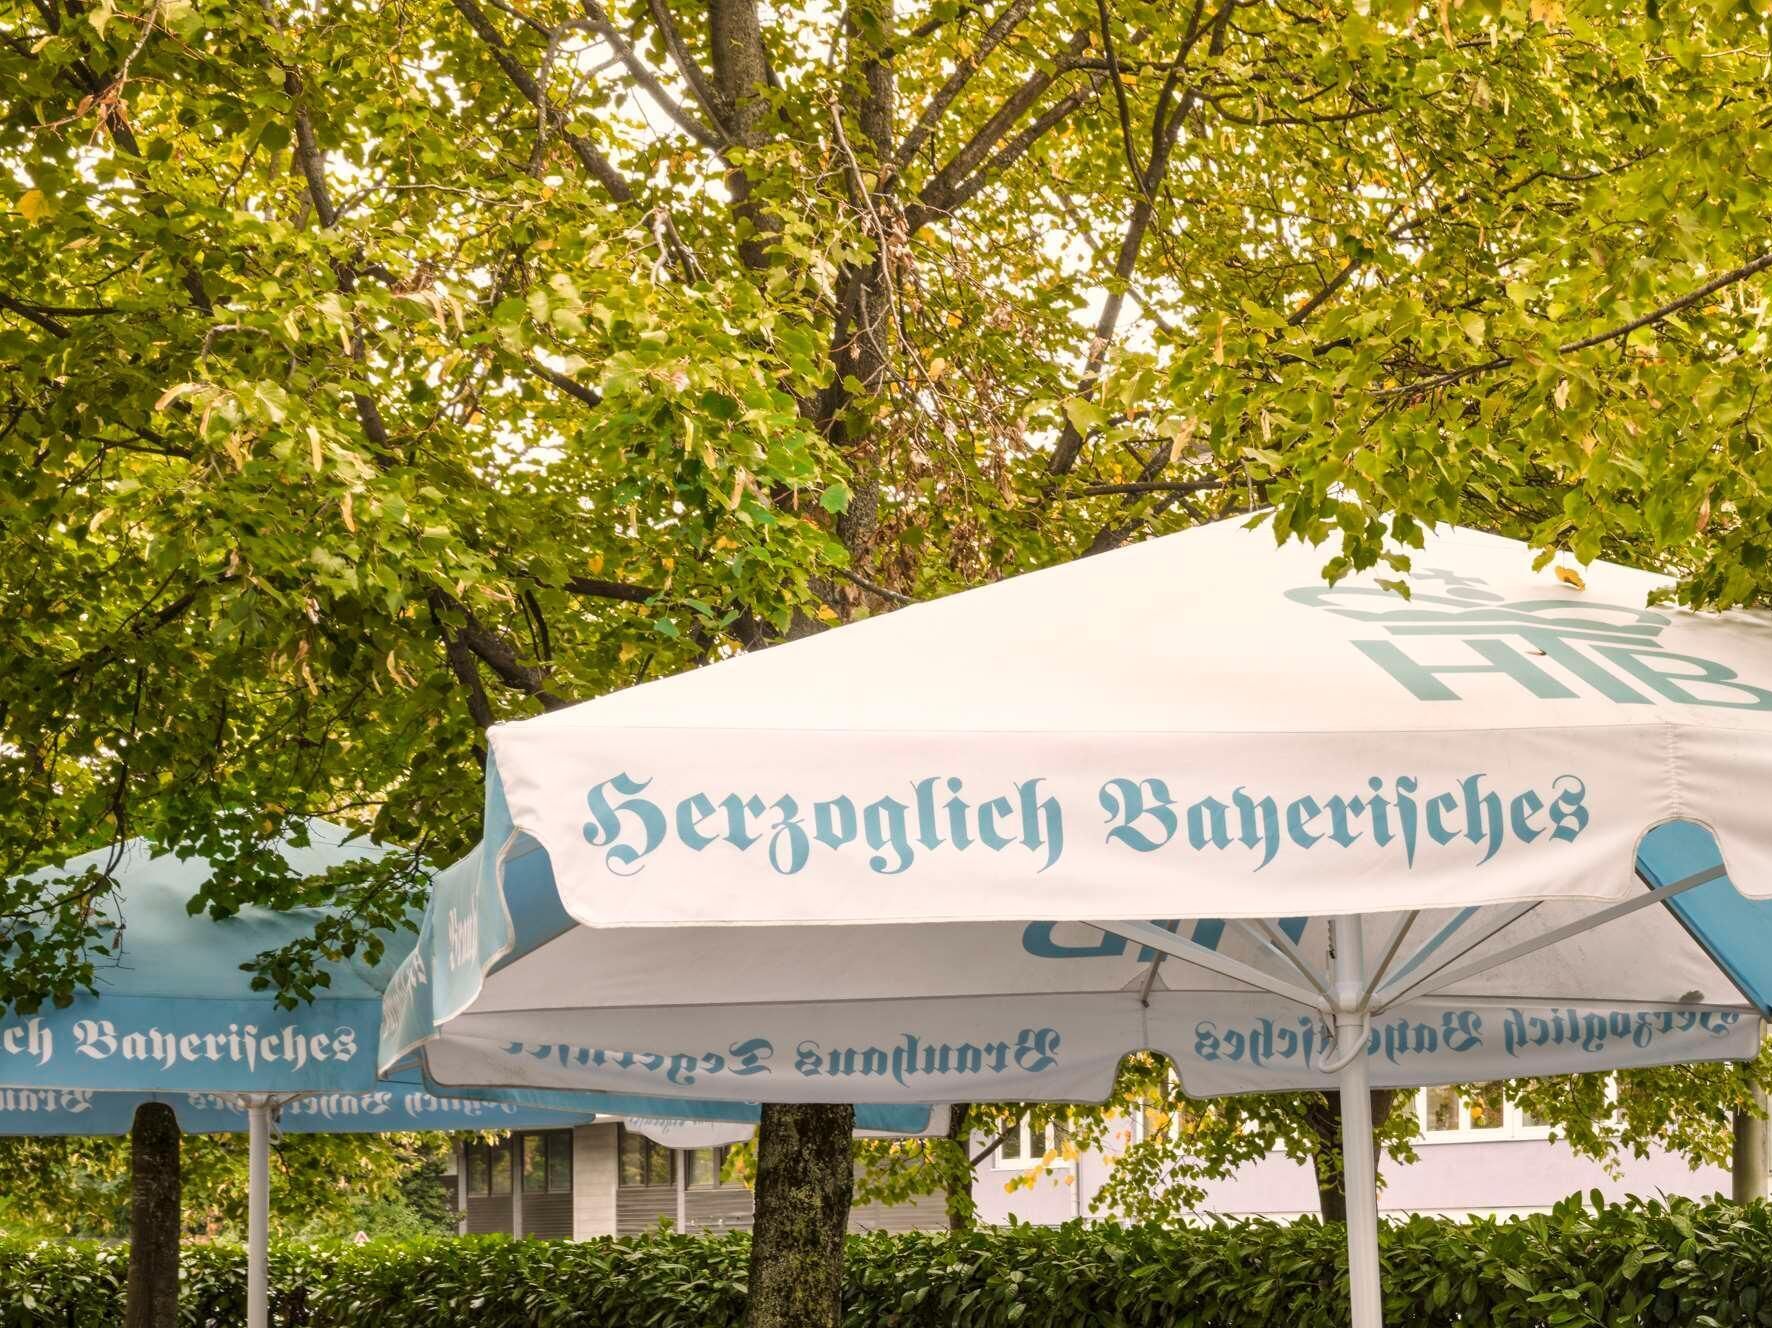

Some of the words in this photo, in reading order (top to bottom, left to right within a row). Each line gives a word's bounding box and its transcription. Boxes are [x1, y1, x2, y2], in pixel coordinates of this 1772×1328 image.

[582, 771, 1065, 877] Herzoglich
[1098, 772, 1590, 873] Bayerisches
[72, 1018, 358, 1073] Bayerisches
